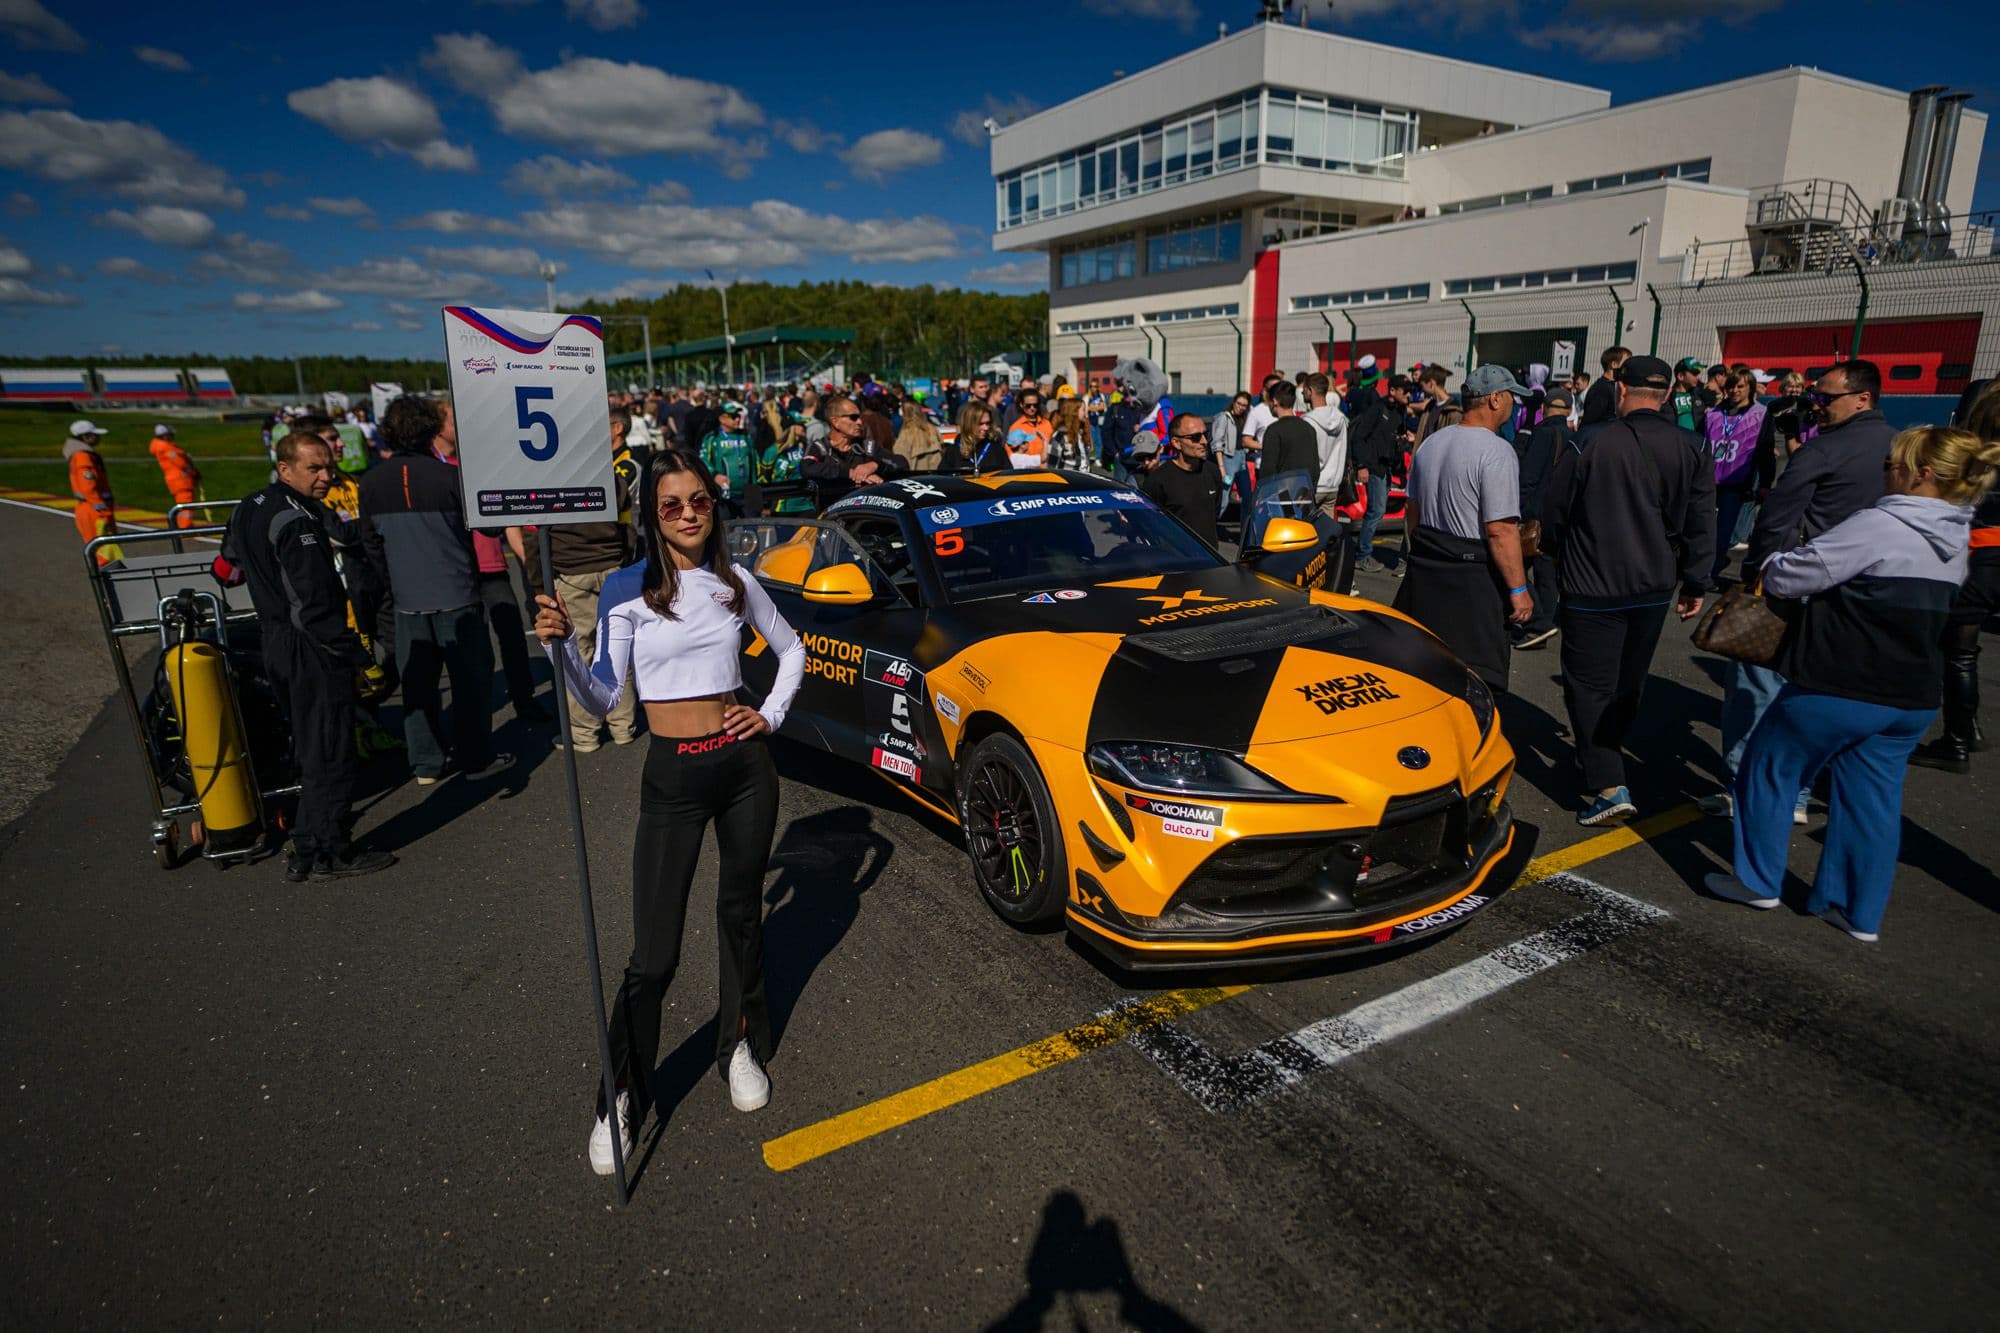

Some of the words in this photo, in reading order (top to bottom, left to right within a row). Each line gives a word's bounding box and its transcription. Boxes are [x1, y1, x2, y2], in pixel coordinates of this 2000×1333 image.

[1559, 355, 1569, 369] 11
[514, 386, 560, 462] 5
[1011, 499, 1046, 512] SMP
[1047, 495, 1104, 507] RACING
[935, 527, 966, 557] 5
[1137, 598, 1280, 626] MOTORSPORT
[802, 631, 863, 664] MOTOR
[803, 655, 858, 686] SPORT
[890, 693, 912, 734] 5
[1314, 685, 1401, 716] DIGITAL
[889, 737, 907, 749] SMP
[882, 755, 899, 769] MEN
[1150, 801, 1215, 822] YOKOHAMA
[1163, 822, 1209, 838] auto.ru
[1394, 893, 1490, 933] YOKOHAMA
